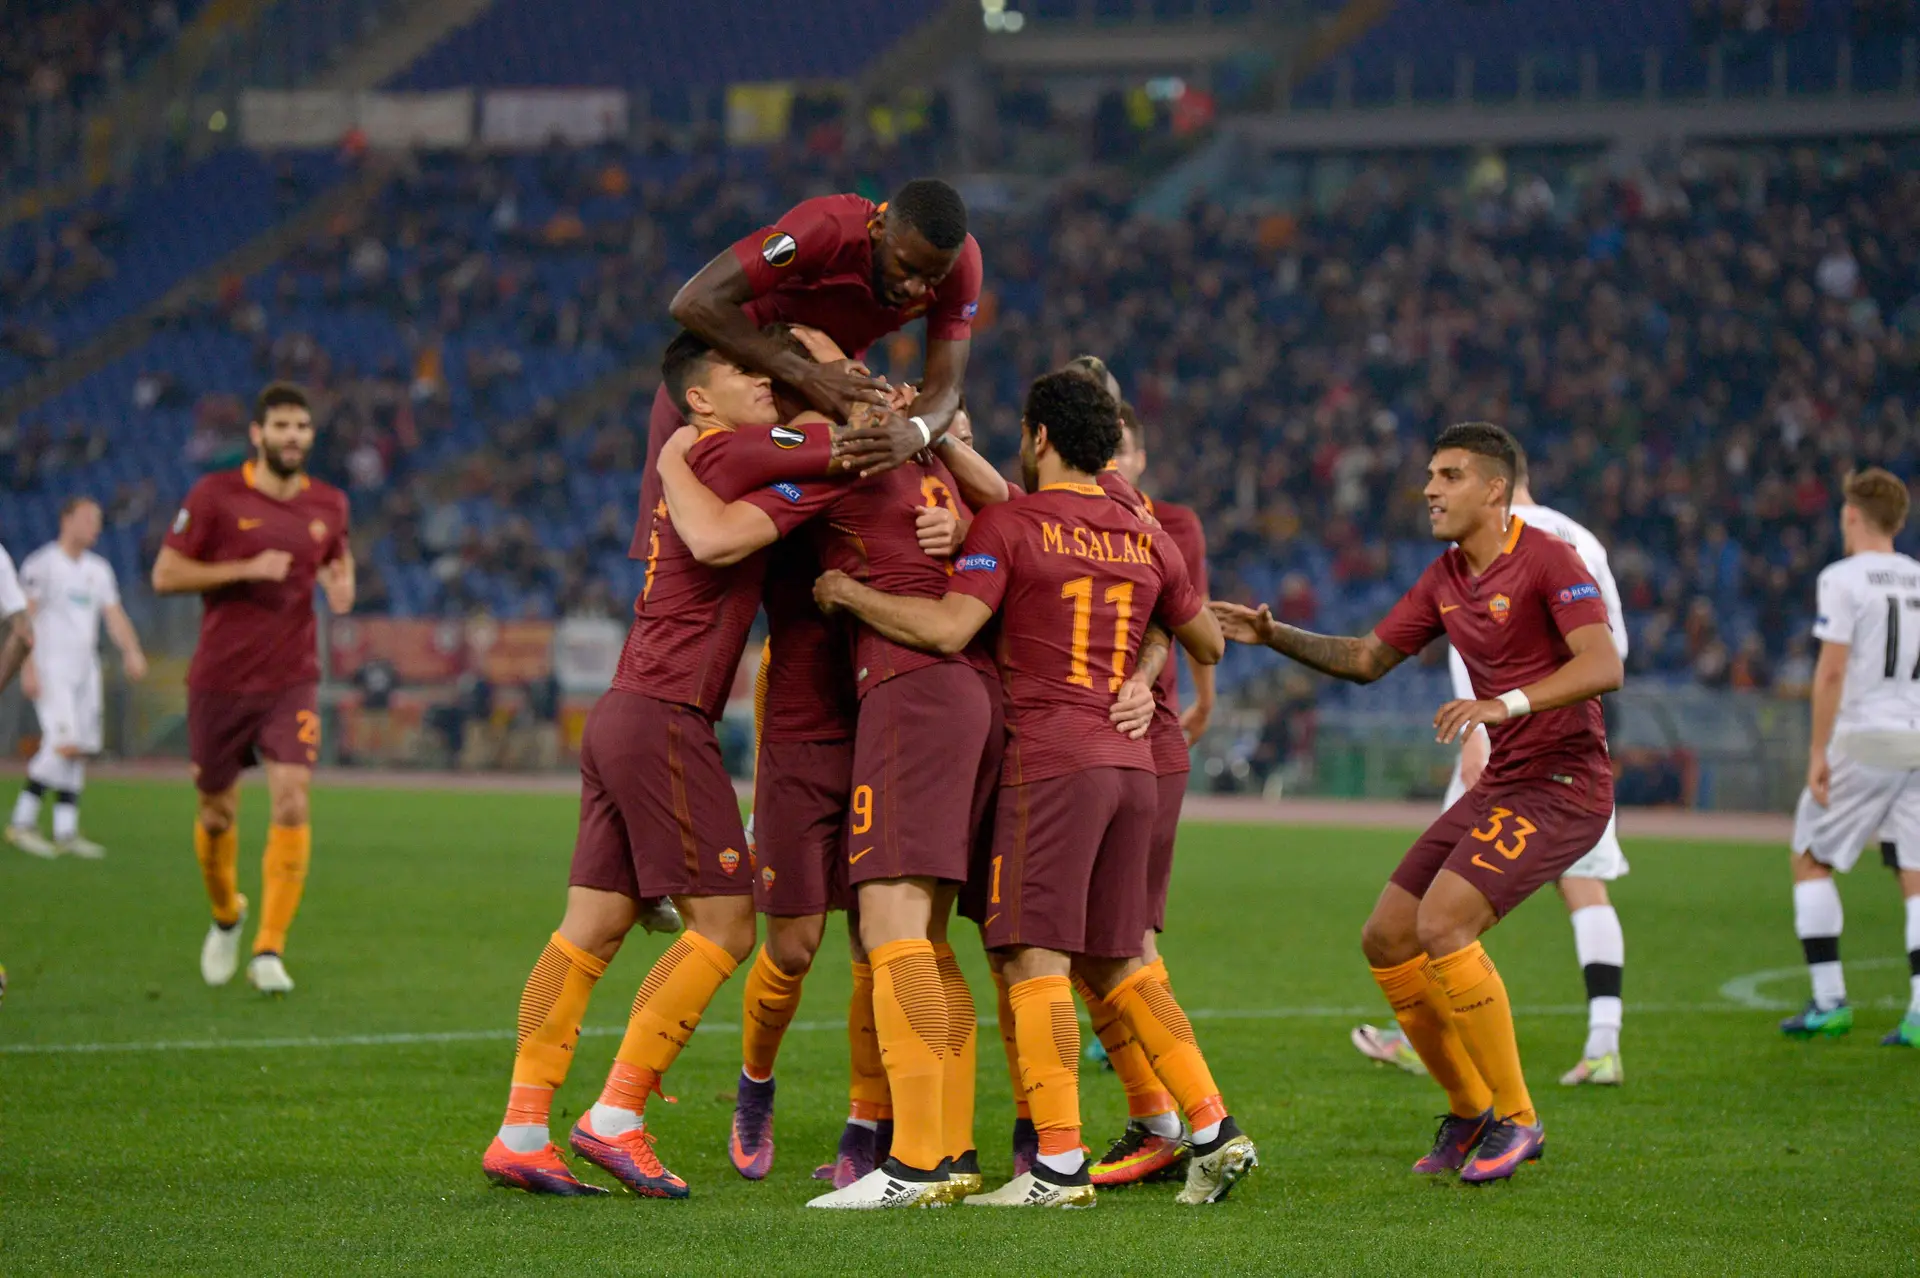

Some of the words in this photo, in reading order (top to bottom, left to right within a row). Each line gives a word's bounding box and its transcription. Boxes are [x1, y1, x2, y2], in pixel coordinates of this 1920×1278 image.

[966, 557, 997, 568] RESPECT
[1041, 522, 1153, 565] M.SALAH
[1061, 576, 1134, 693] 11
[852, 784, 873, 835] 9
[1471, 806, 1538, 861] 33
